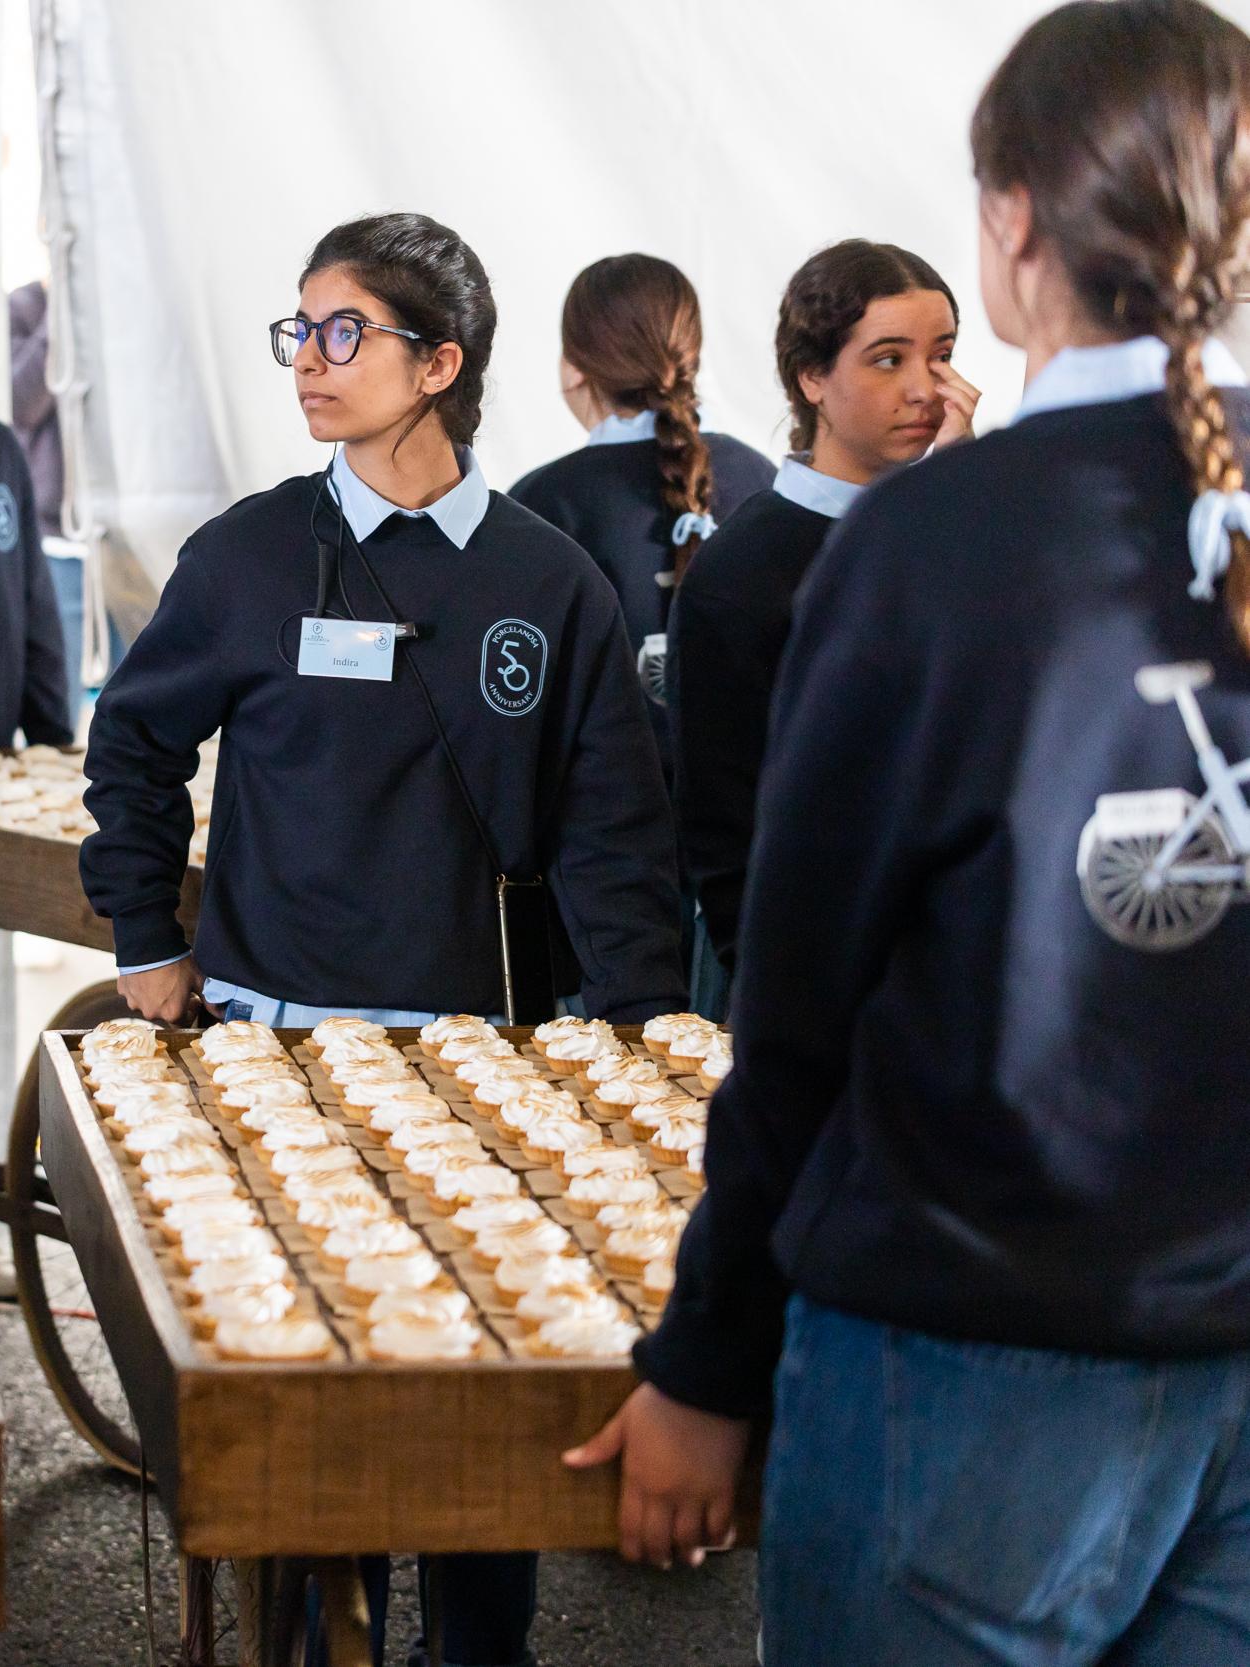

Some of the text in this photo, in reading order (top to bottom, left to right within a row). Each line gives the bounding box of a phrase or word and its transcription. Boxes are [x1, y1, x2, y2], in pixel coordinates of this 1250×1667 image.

[492, 626, 539, 649] PORCELANOSA
[333, 657, 359, 667] Indira
[497, 640, 530, 692] 50
[488, 682, 534, 708] ANNIVERSARY
